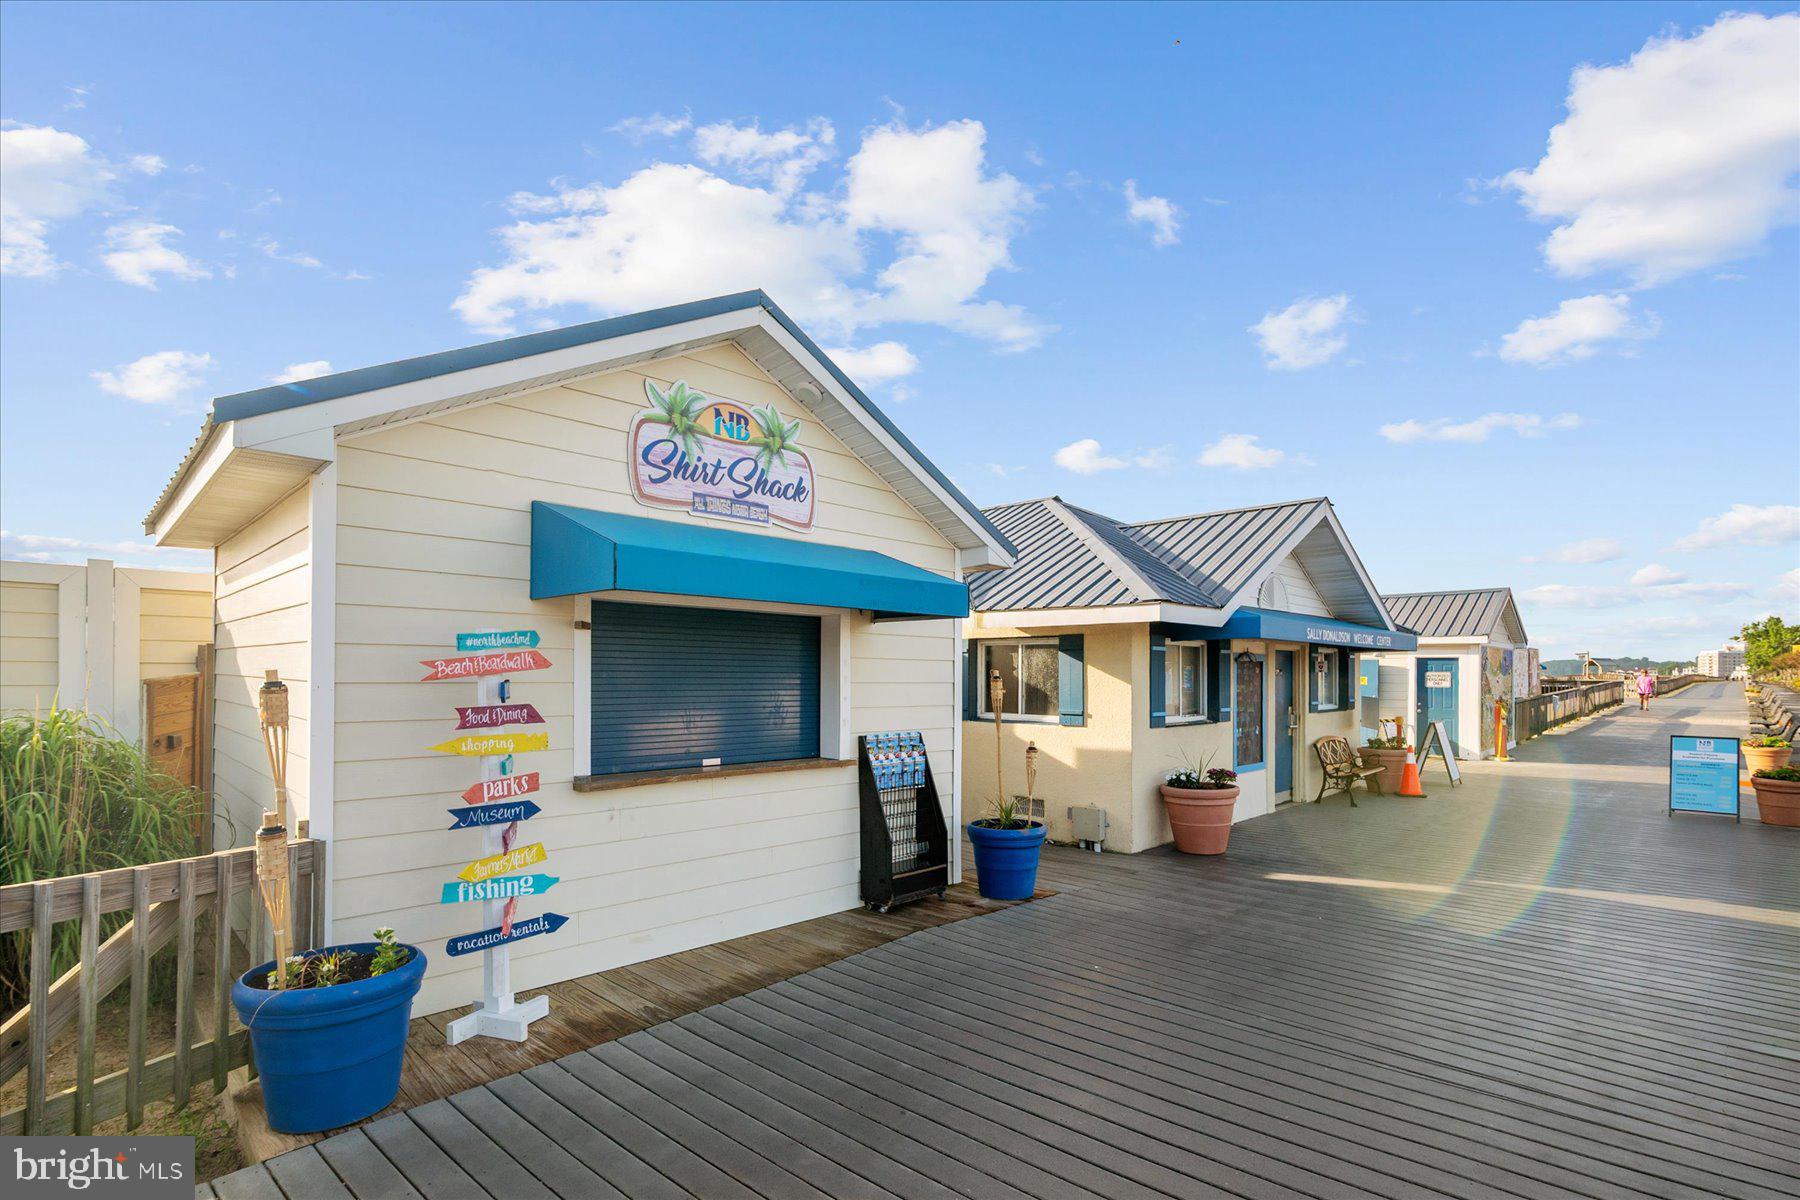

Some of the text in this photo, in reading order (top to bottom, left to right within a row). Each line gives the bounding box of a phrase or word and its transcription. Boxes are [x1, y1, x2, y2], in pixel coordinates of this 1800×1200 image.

[713, 407, 751, 442] NB
[641, 438, 810, 503] Shirt Shack
[466, 632, 531, 647] #northbeachmd
[1307, 627, 1392, 647] SALLY DONALDSON WELCOME CENTER
[435, 658, 473, 677] Beach
[479, 652, 535, 673] Boardwalk
[466, 708, 491, 727] Food
[497, 707, 528, 725] Dining
[461, 738, 515, 754] shopping
[483, 775, 529, 802] parks
[460, 805, 524, 827] Museum
[457, 876, 535, 903] fishing
[511, 917, 551, 937] rentals
